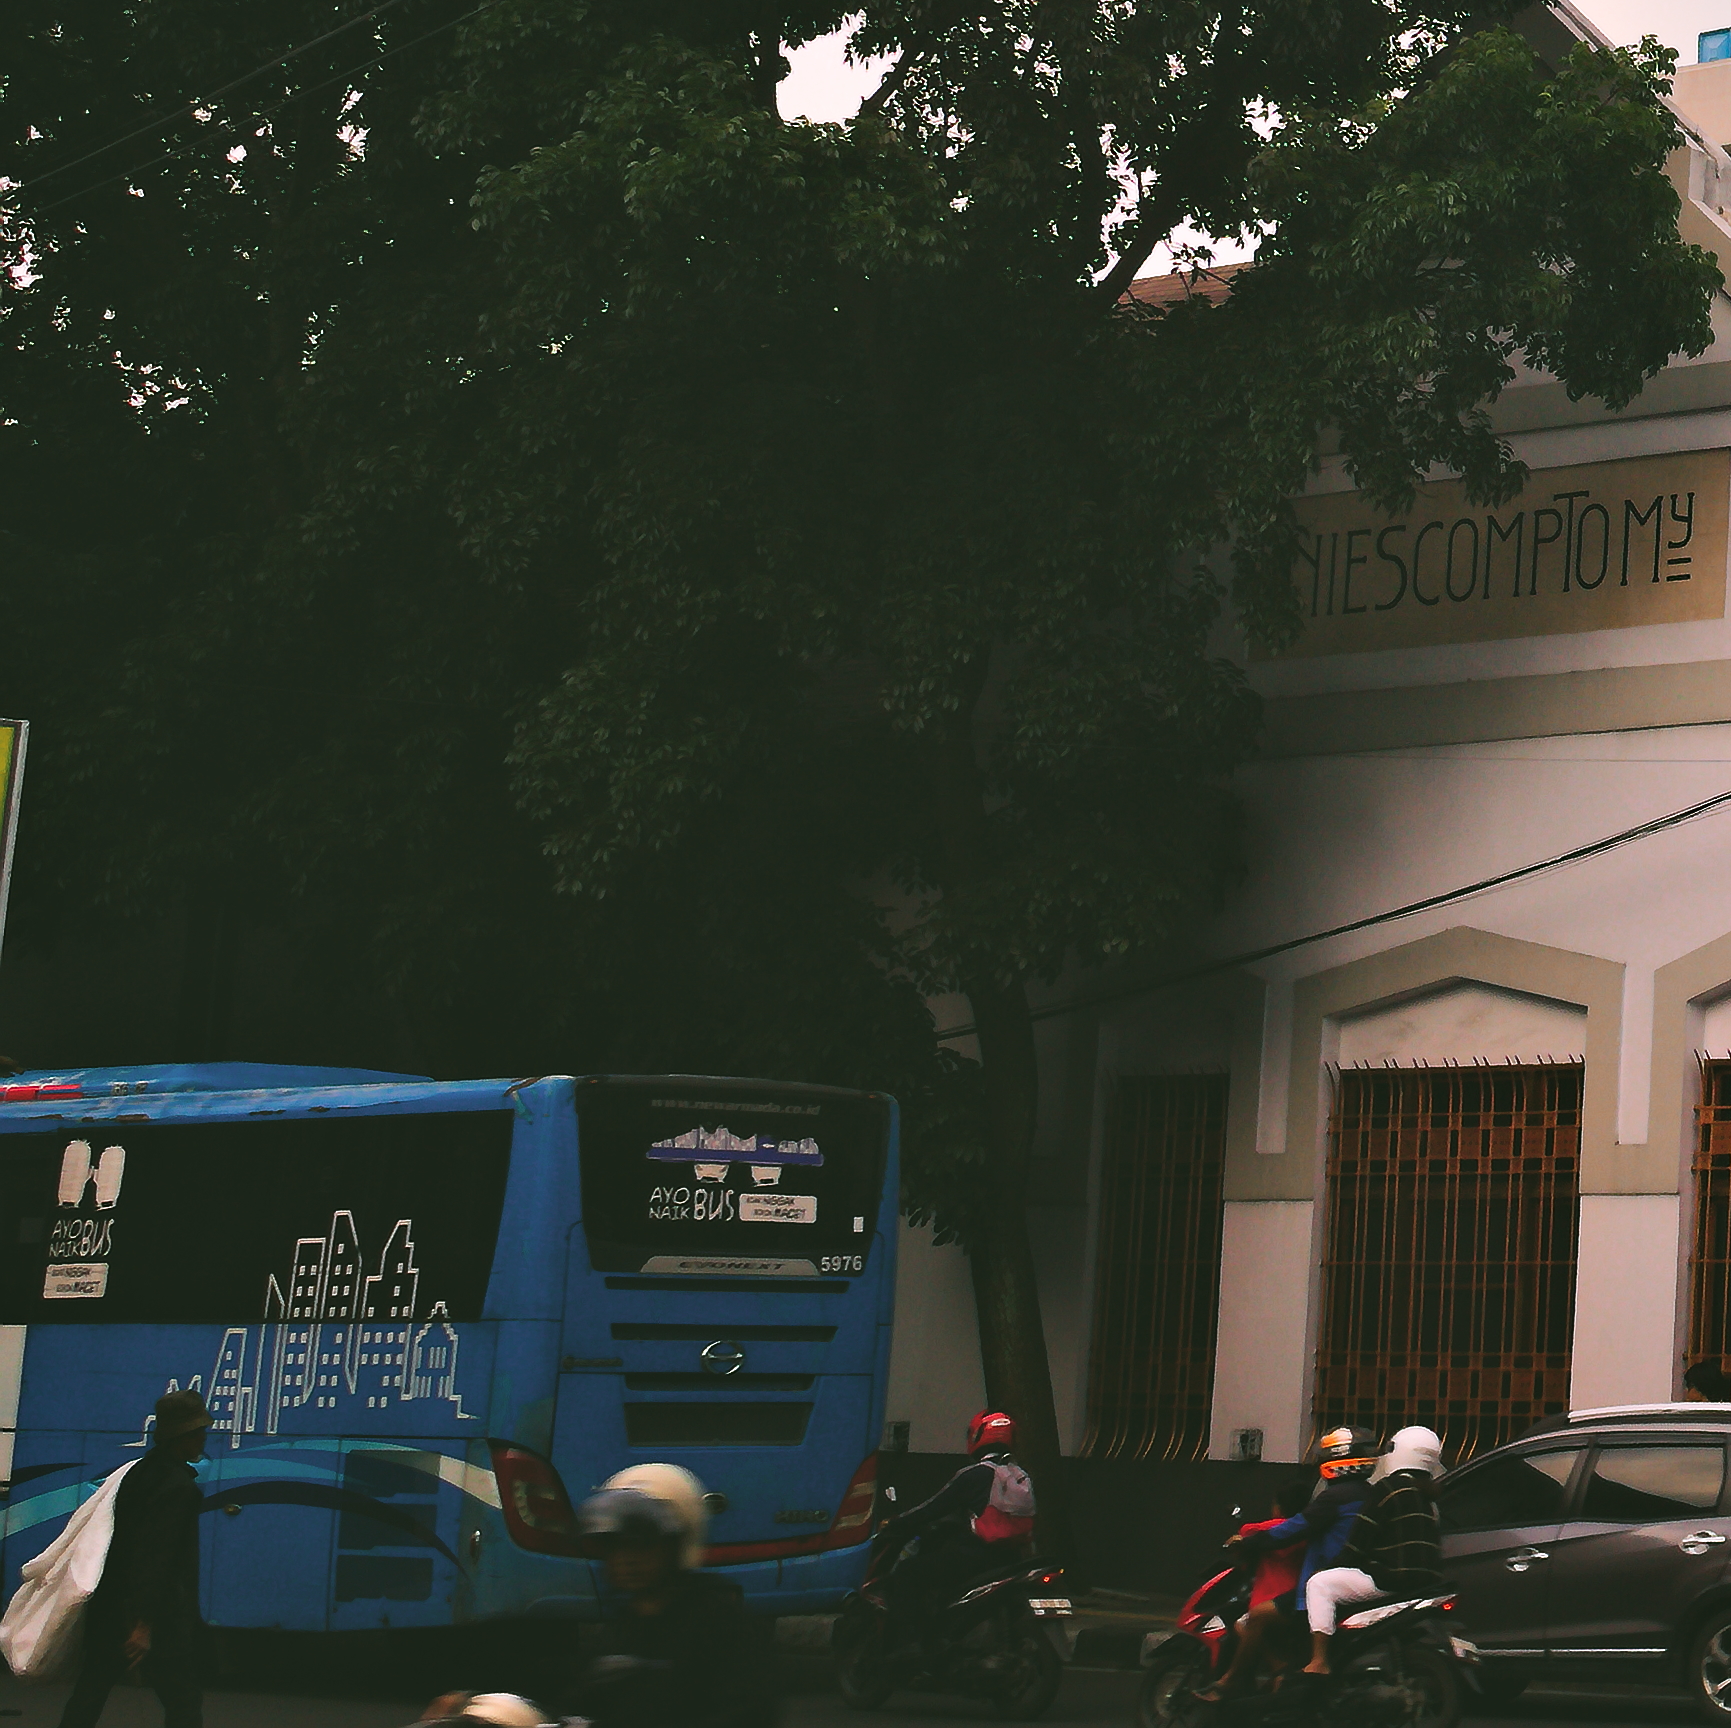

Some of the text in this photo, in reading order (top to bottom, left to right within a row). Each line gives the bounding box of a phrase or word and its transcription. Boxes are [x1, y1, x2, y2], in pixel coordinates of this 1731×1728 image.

[650, 1187, 691, 1204] AYO
[693, 1188, 735, 1221] BUS
[650, 1206, 690, 1221] NAIK
[52, 1219, 81, 1239] AYO
[79, 1219, 115, 1256] BUS
[49, 1240, 80, 1257] NAIK
[820, 1256, 863, 1272] 5976
